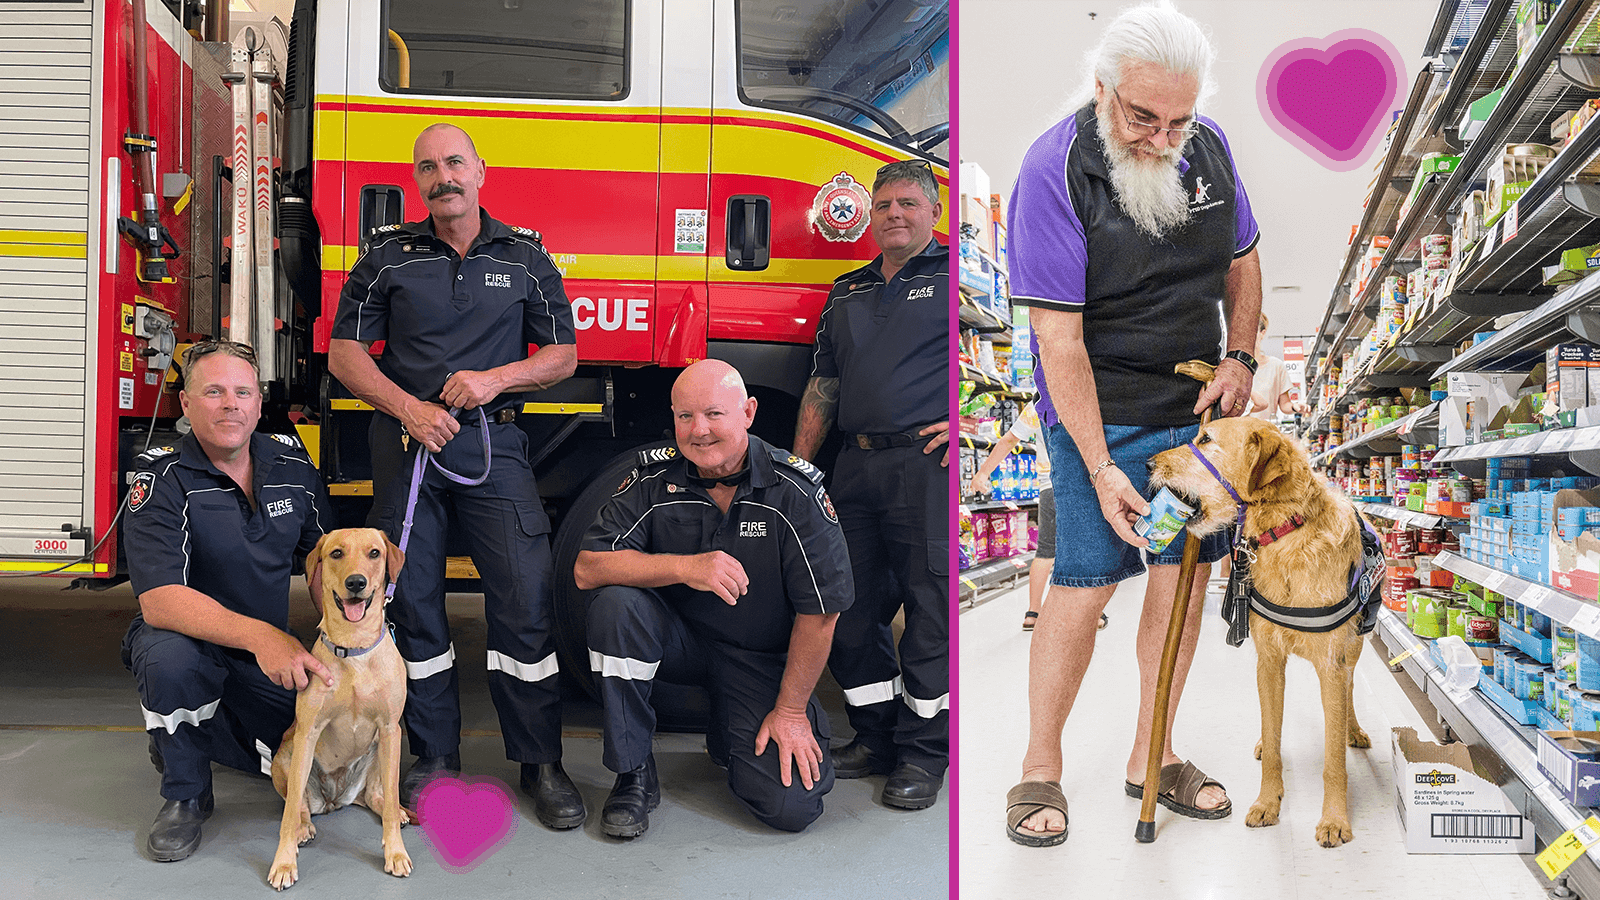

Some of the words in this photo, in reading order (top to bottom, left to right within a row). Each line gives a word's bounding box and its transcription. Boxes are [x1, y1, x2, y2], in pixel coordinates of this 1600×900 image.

[559, 255, 577, 264] AIR
[485, 273, 511, 283] FIRE
[908, 285, 935, 297] FIRE
[906, 292, 934, 301] RESCUE
[266, 498, 293, 513] FIRE
[269, 507, 294, 518] RESCUE
[740, 521, 767, 531] FIRE
[739, 530, 767, 538] RESCUE
[35, 540, 67, 550] 3000
